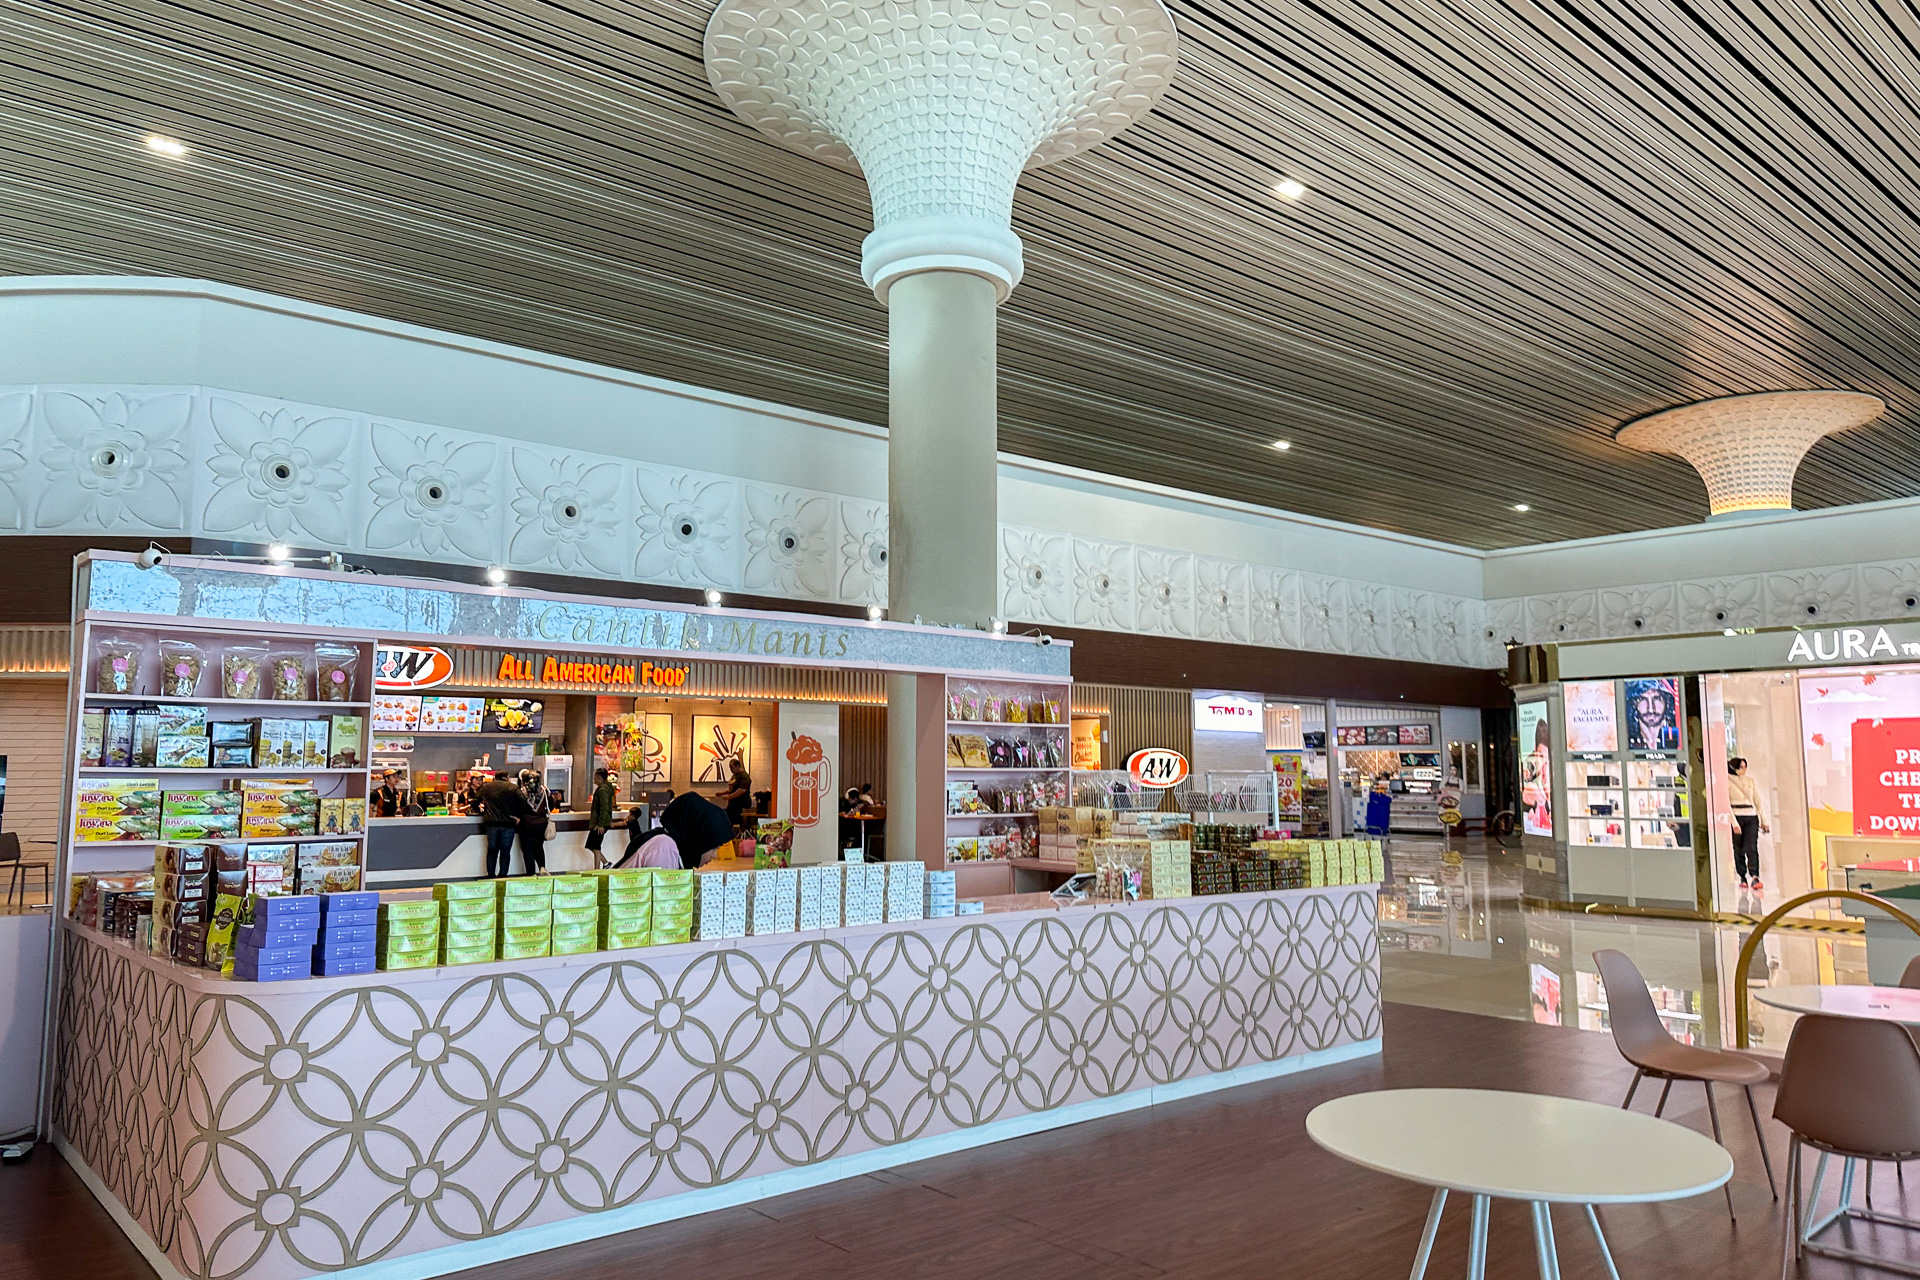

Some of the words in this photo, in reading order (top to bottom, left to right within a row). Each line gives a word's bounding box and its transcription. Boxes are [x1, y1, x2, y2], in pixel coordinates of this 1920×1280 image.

[538, 605, 701, 650] Cantik
[717, 620, 849, 656] Manis
[1787, 626, 1899, 661] AURA
[498, 653, 535, 681] ALL
[542, 656, 636, 685] AMERICAN
[1573, 715, 1611, 723] EXCLUSIVE
[1141, 758, 1178, 779] A&W
[81, 793, 114, 803] Juwana
[167, 793, 198, 803] Juwana
[80, 818, 113, 829] Juwana
